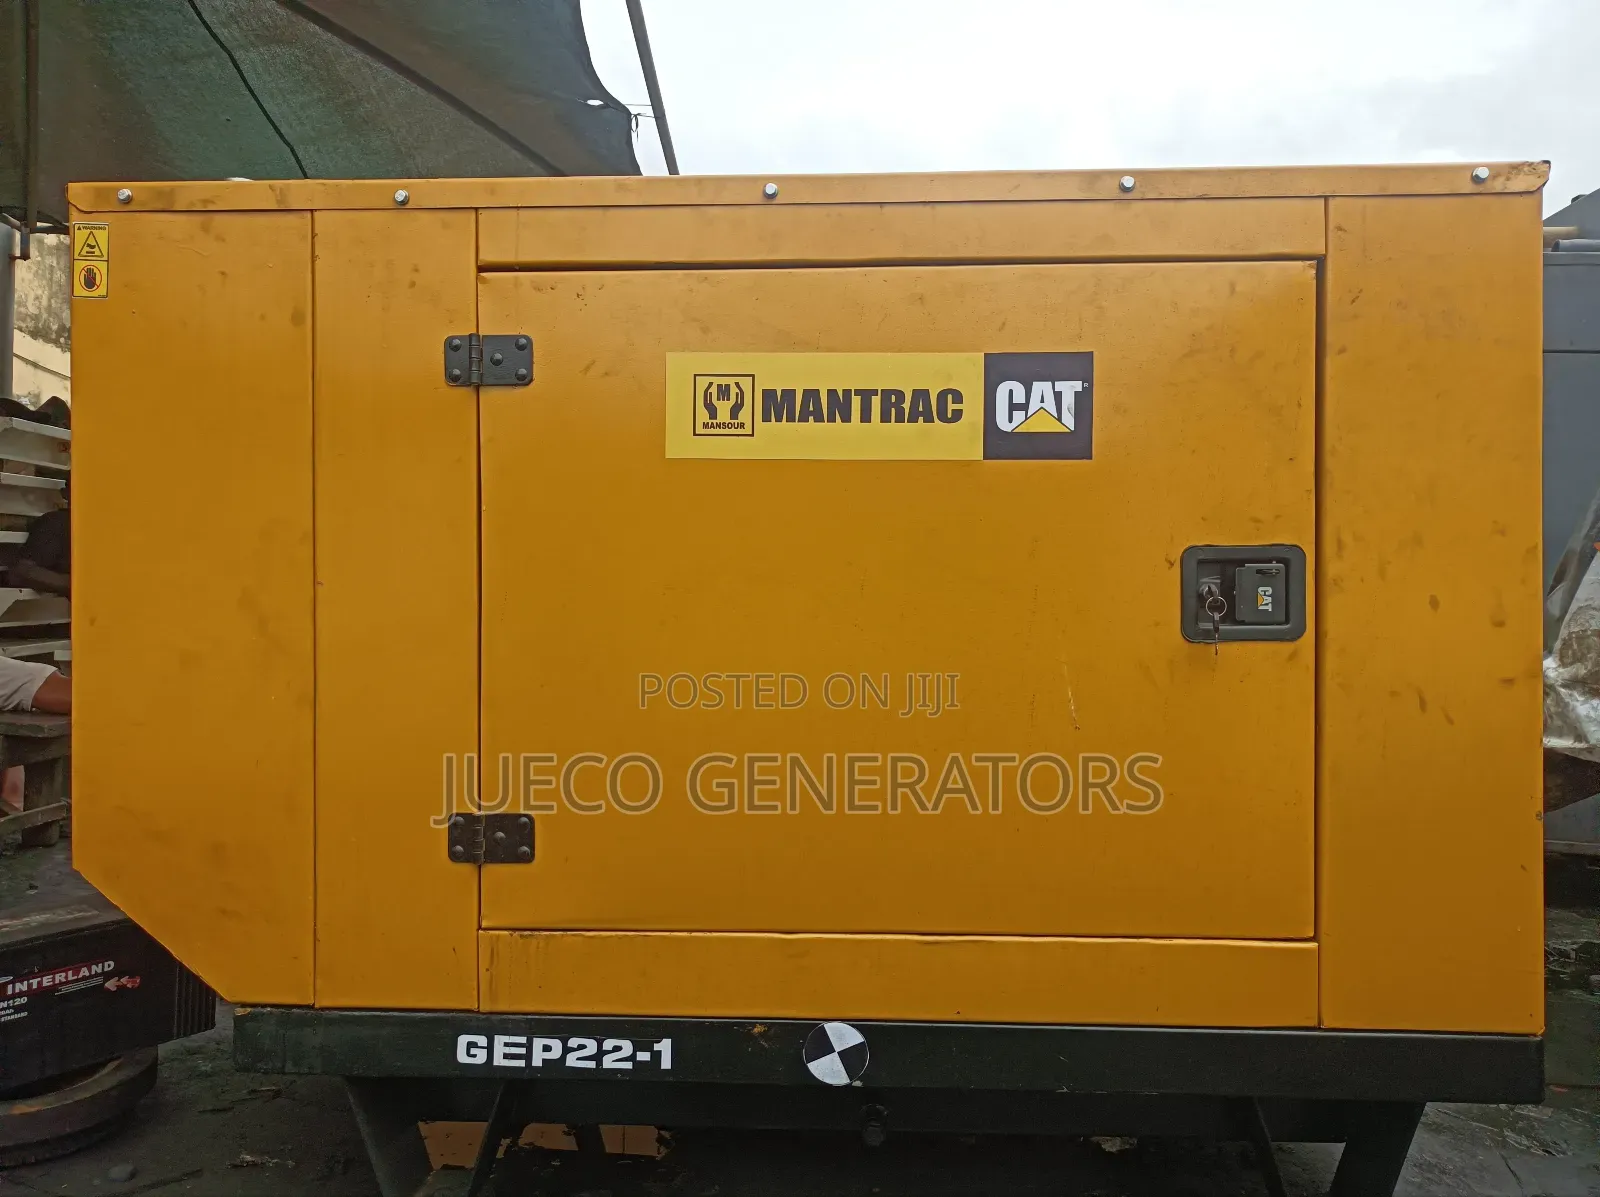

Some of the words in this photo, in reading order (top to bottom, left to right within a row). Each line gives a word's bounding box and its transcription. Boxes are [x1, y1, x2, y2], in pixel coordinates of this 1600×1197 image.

[716, 383, 731, 402] M
[761, 388, 964, 424] MANTRAC
[995, 380, 1083, 433] CAT
[702, 421, 746, 430] MANSOUR
[1257, 586, 1273, 612] CAT
[7, 960, 115, 996] INTERLAND
[456, 1033, 673, 1070] GEP22-1
